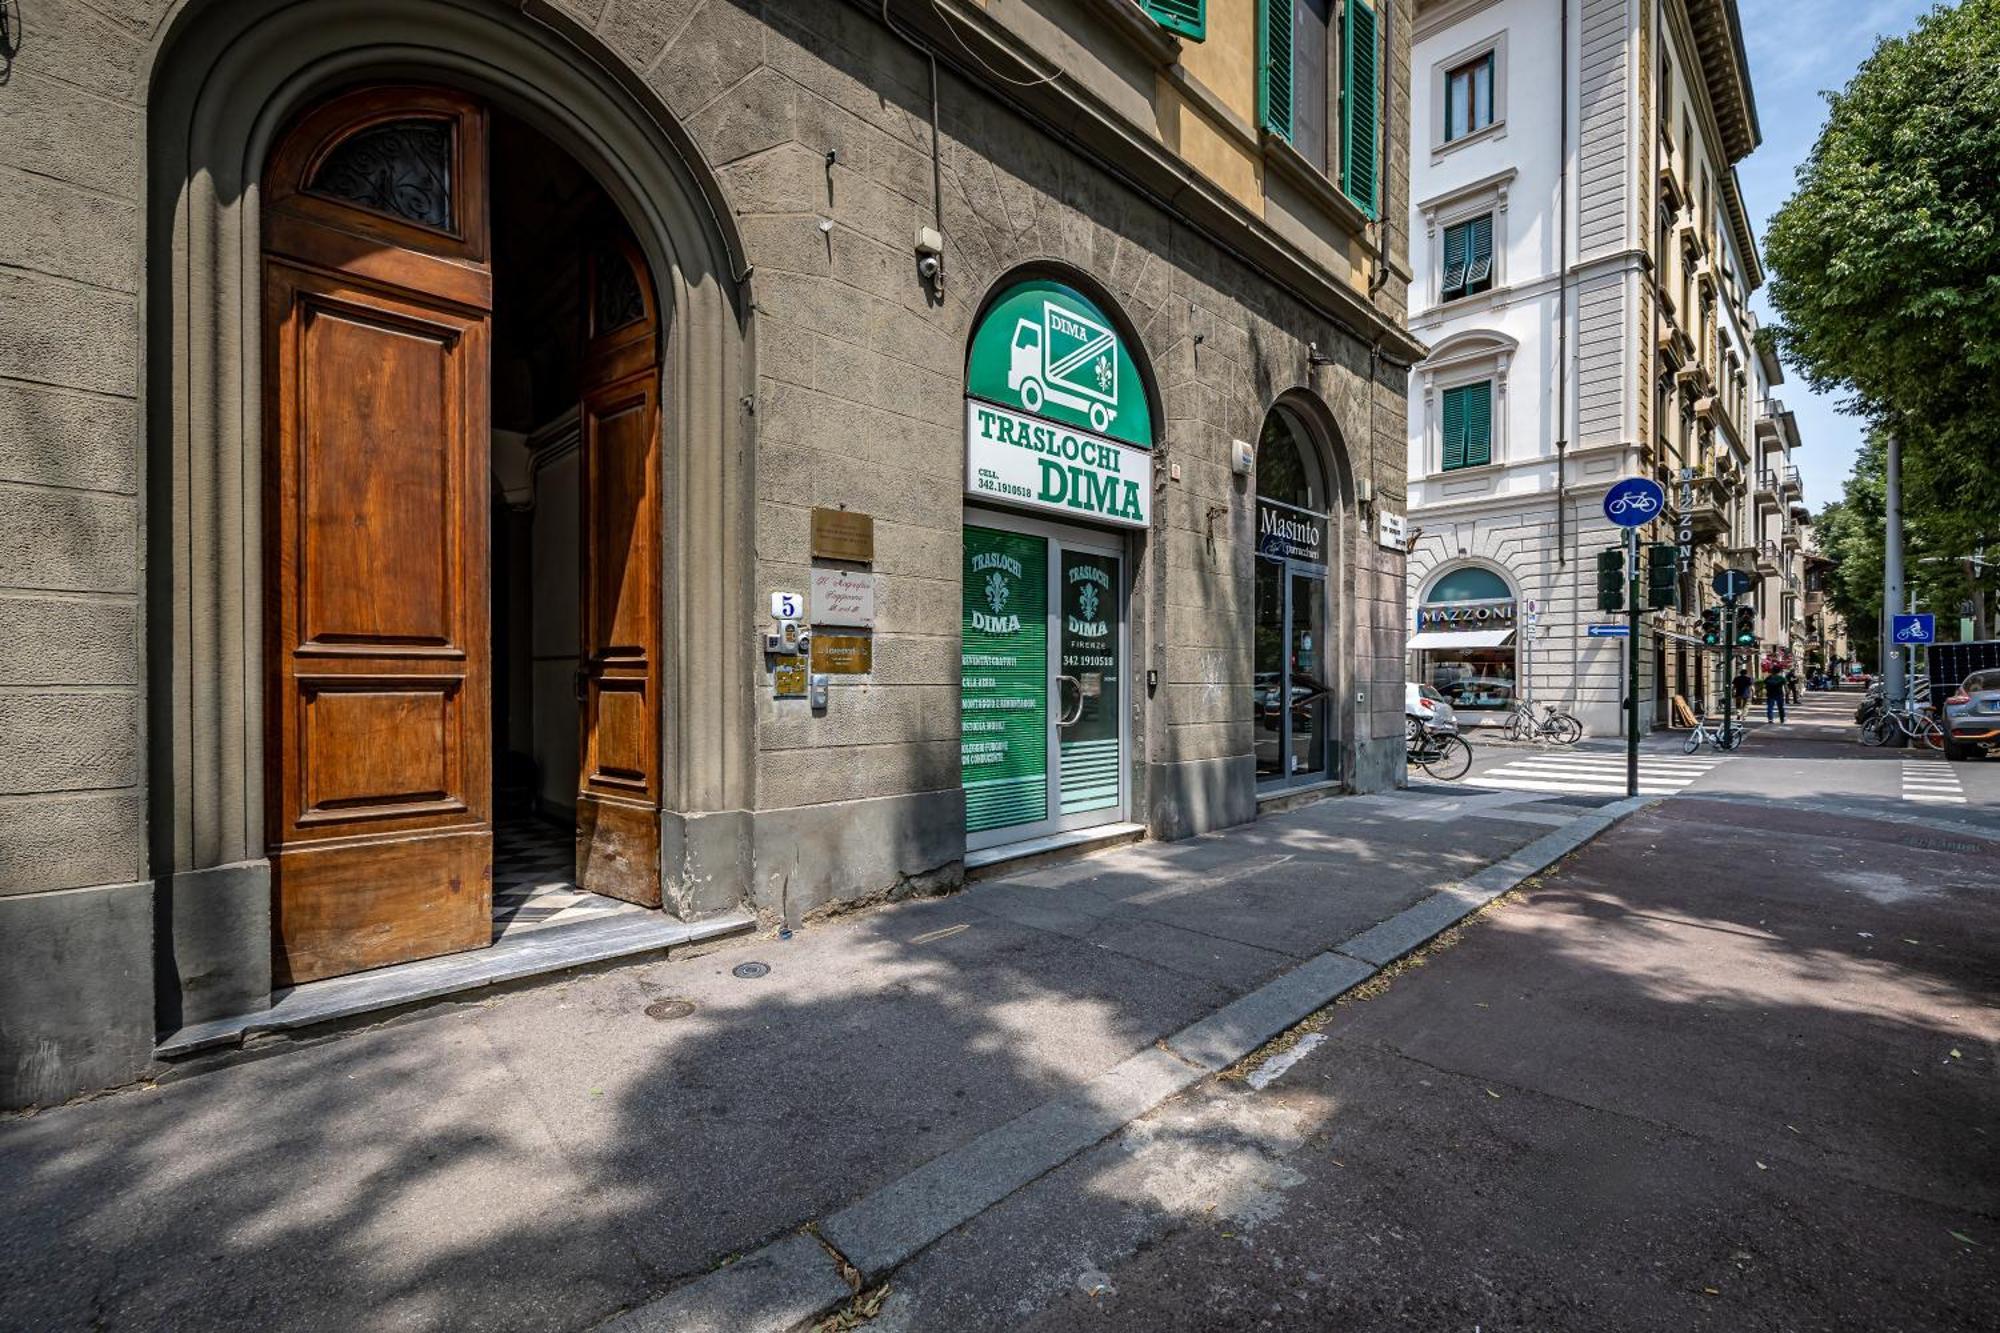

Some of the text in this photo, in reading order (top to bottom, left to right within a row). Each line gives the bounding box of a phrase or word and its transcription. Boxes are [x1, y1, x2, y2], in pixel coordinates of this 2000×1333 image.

[1051, 314, 1087, 342] DIMA
[978, 410, 1121, 473] TRASLOCHI
[978, 468, 999, 480] CELL.
[978, 478, 1032, 498] 342.1910518
[1037, 457, 1144, 521] DIMA
[1260, 507, 1320, 546] Masinto
[1680, 468, 1693, 573] MAZZONI
[971, 552, 1022, 579] TRASLOCHI
[1068, 564, 1109, 590] TRASLOCHI
[782, 595, 795, 617] 5
[1422, 606, 1513, 622] MAZZONI
[971, 608, 1021, 634] DIMA
[1068, 614, 1109, 637] DIMA
[1071, 641, 1107, 650] FIRENZE
[1063, 655, 1114, 667] 342 1910518
